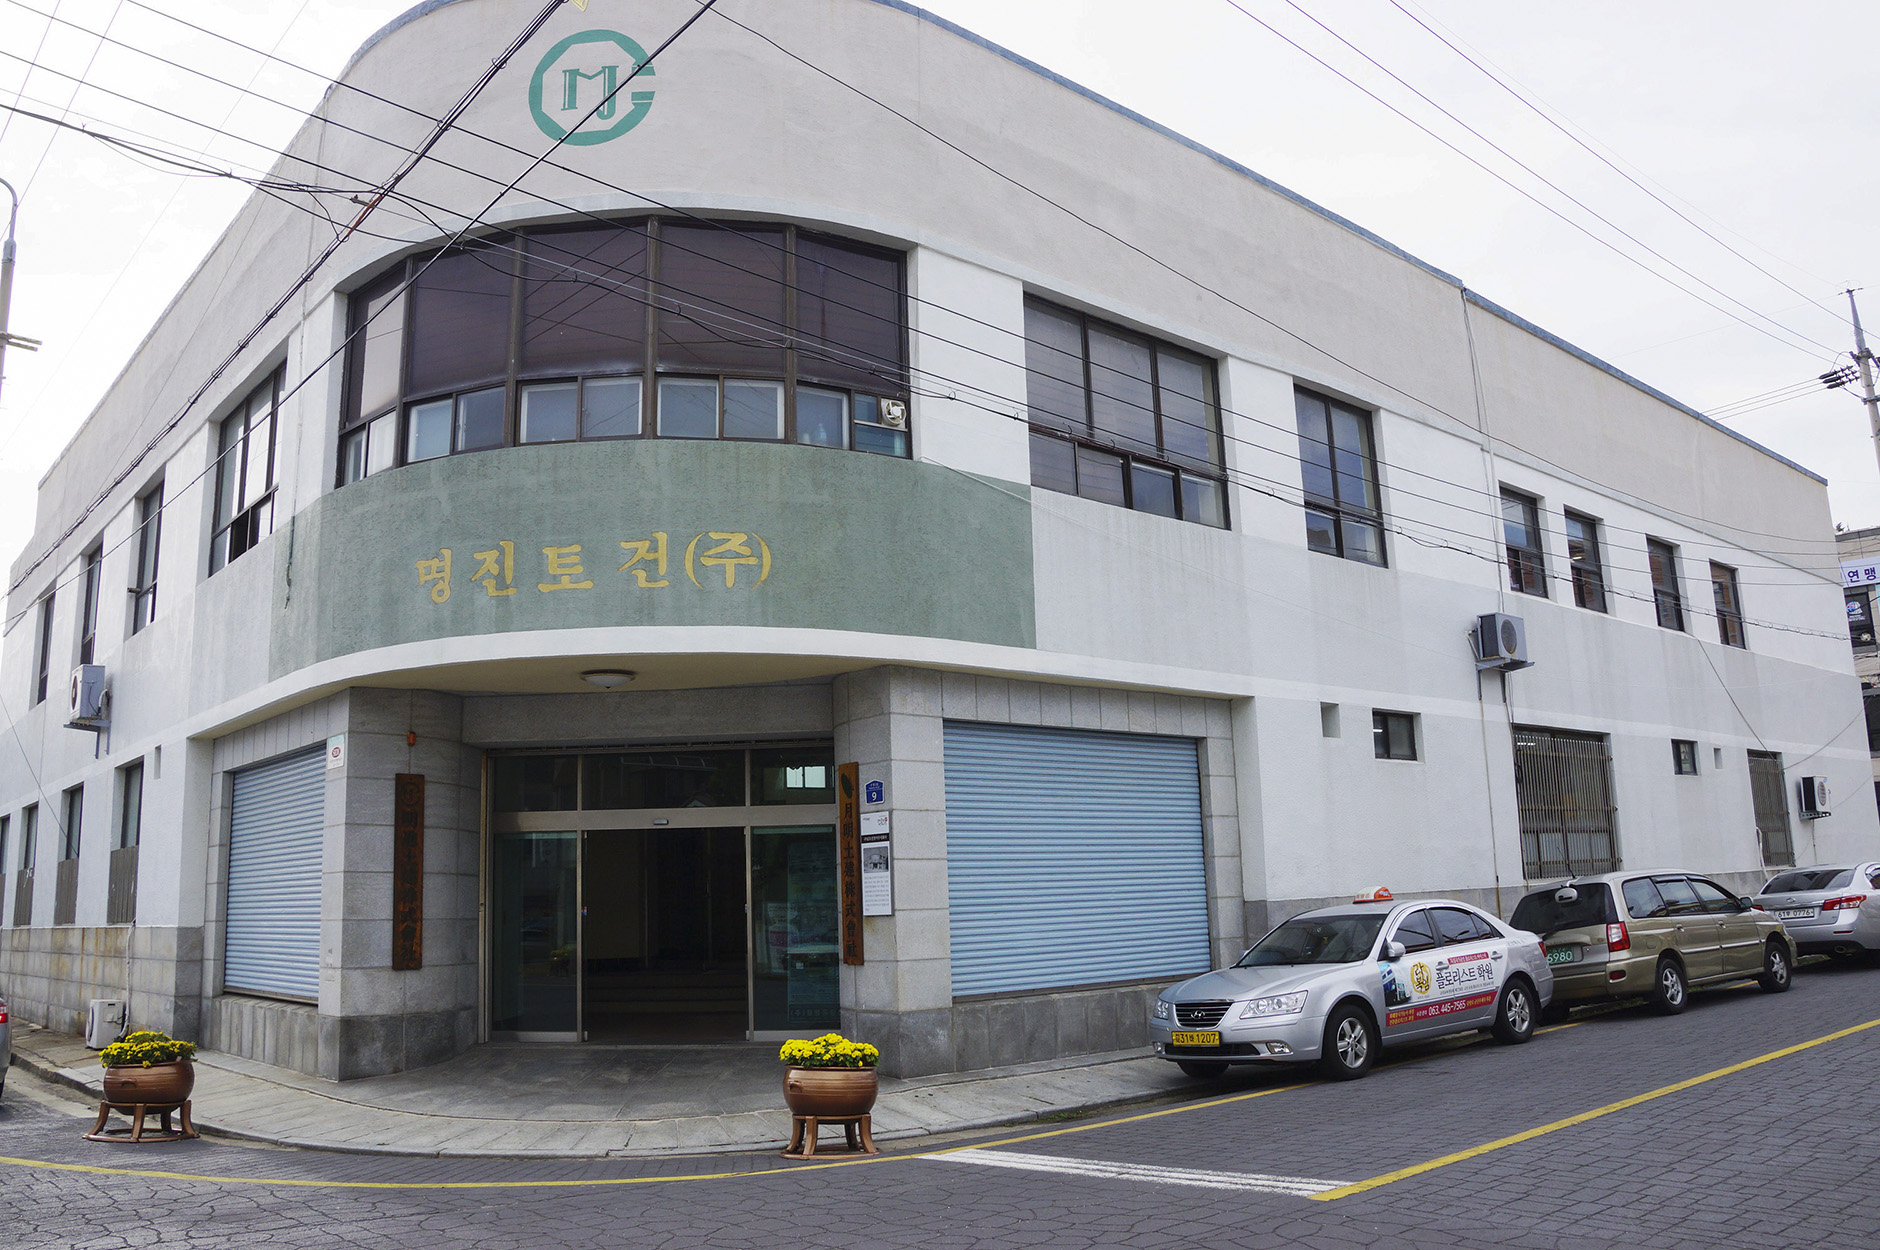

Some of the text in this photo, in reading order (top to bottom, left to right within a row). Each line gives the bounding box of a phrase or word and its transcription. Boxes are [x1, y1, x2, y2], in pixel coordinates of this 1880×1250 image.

[414, 531, 772, 604] 명진토건(주)
[1847, 567, 1877, 583] 연맹
[871, 791, 877, 801] 9
[1547, 951, 1573, 963] 5980
[1436, 968, 1478, 989] 플로리스트
[1477, 962, 1494, 981] 학원
[1196, 1034, 1216, 1043] 1207
